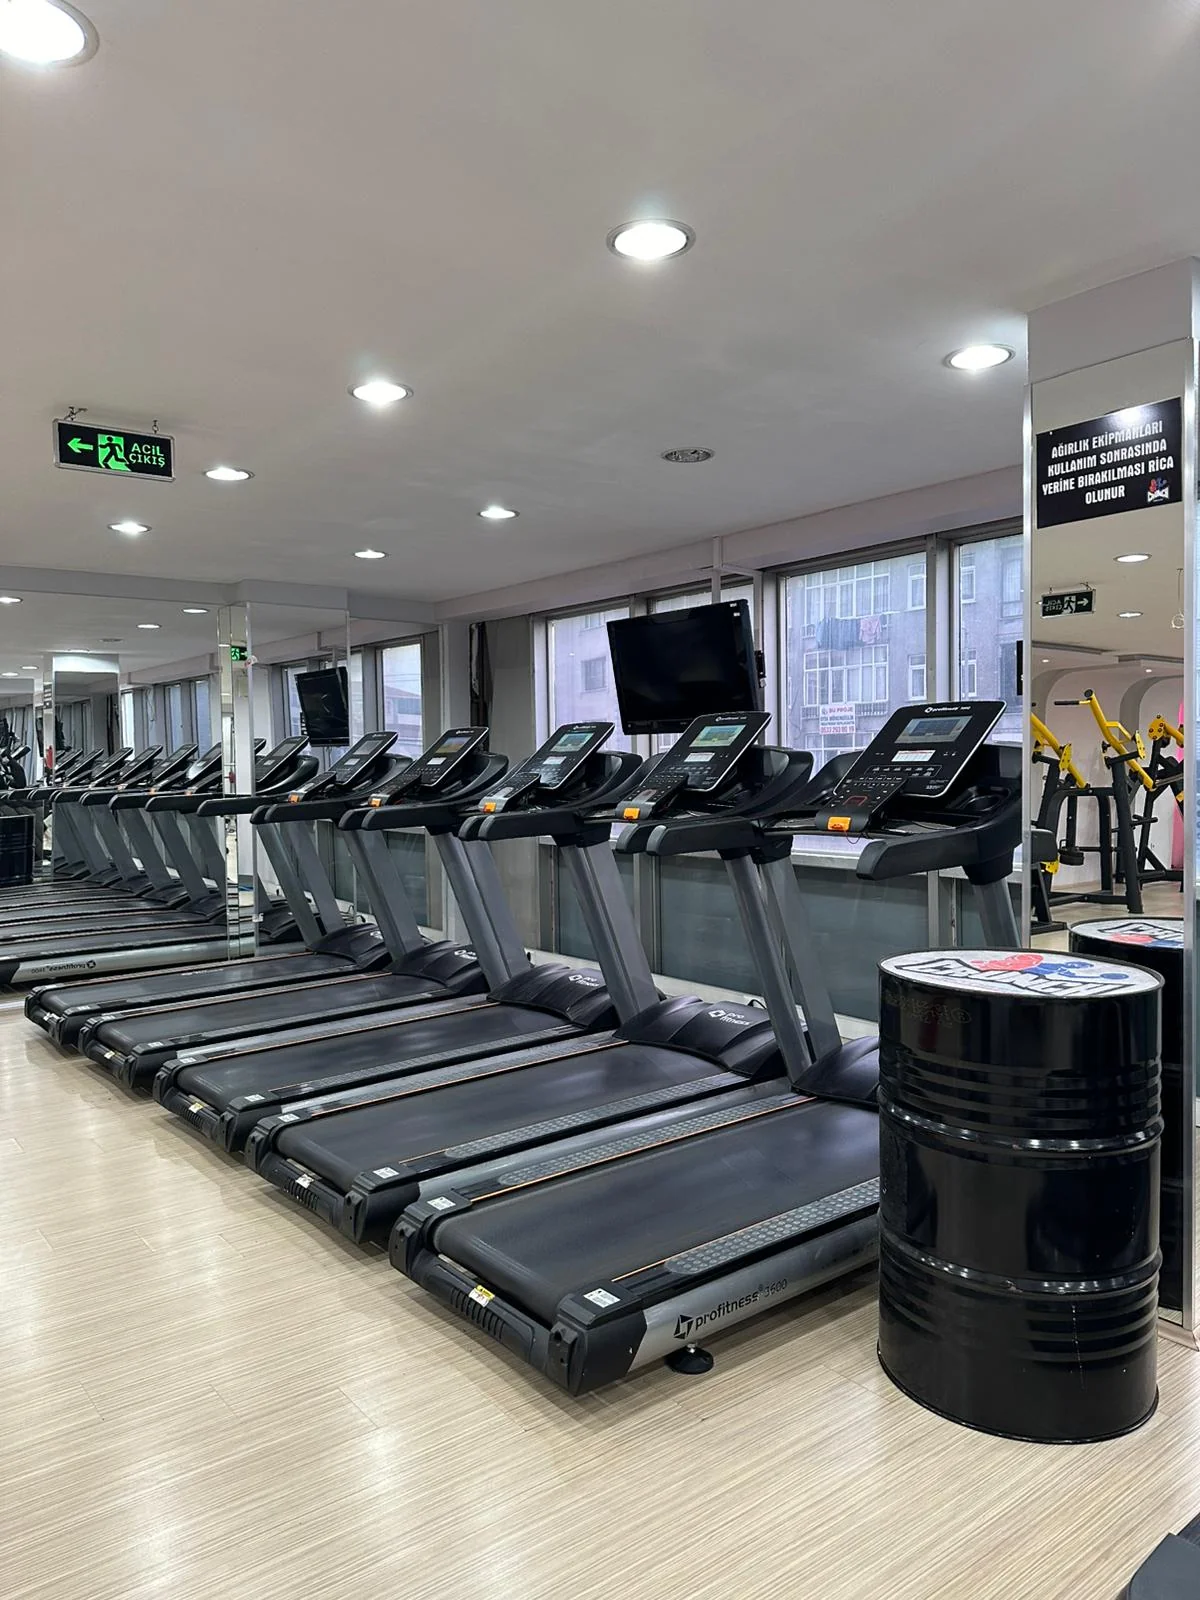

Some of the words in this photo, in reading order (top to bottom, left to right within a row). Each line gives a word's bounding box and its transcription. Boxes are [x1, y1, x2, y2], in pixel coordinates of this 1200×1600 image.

[1047, 454, 1097, 477] KULLANIM
[1100, 438, 1167, 465] SONRASINDA
[1051, 438, 1090, 459] AĞIRLIK
[1092, 420, 1163, 449] EKİPMANLARI
[128, 453, 166, 468] ÇIKIŞ
[1042, 477, 1075, 496] YERİNE
[1077, 461, 1145, 488] BIRAKILMASI
[1148, 455, 1174, 473] RİCA
[1085, 485, 1126, 505] OLUNUR
[695, 1290, 760, 1331] profitness
[764, 1278, 788, 1298] 3600
